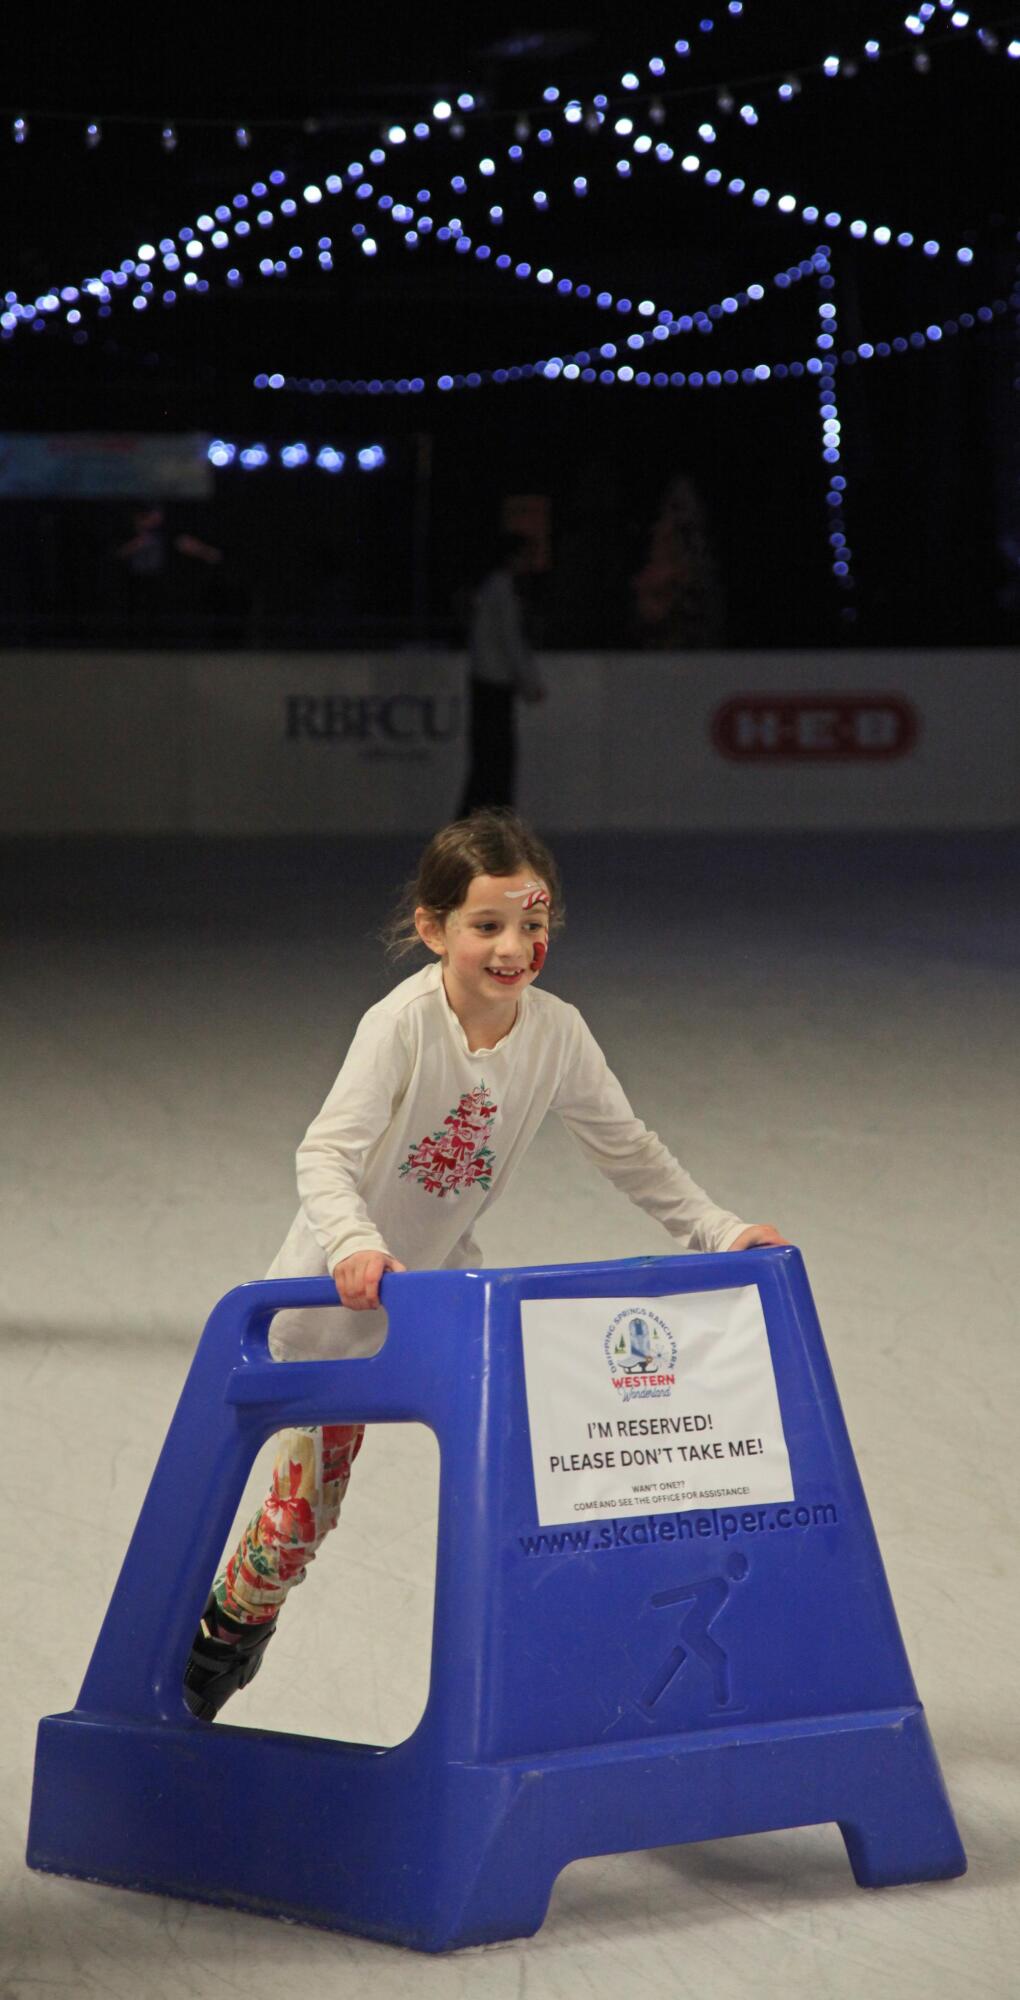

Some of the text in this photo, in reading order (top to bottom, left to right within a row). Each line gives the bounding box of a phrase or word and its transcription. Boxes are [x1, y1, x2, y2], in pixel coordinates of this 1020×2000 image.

[284, 694, 462, 741] RBFCU
[603, 1307, 678, 1374] DRIPPING SPRINGS RANCH PARK
[611, 1374, 675, 1389] WESTERN
[618, 1386, 671, 1402] Wonderland
[587, 1414, 713, 1440] I'M RESERVED!
[549, 1438, 764, 1473] PLEASE DON'T TAKE ME!
[618, 1498, 633, 1507] SEE
[634, 1496, 650, 1505] THE
[651, 1494, 681, 1504] OFFICE
[681, 1491, 698, 1501] FOR
[698, 1486, 751, 1499] ASSISTANCE!
[631, 1480, 686, 1493] WAN'T ONE??
[518, 1503, 838, 1555] www.skatehelper.com
